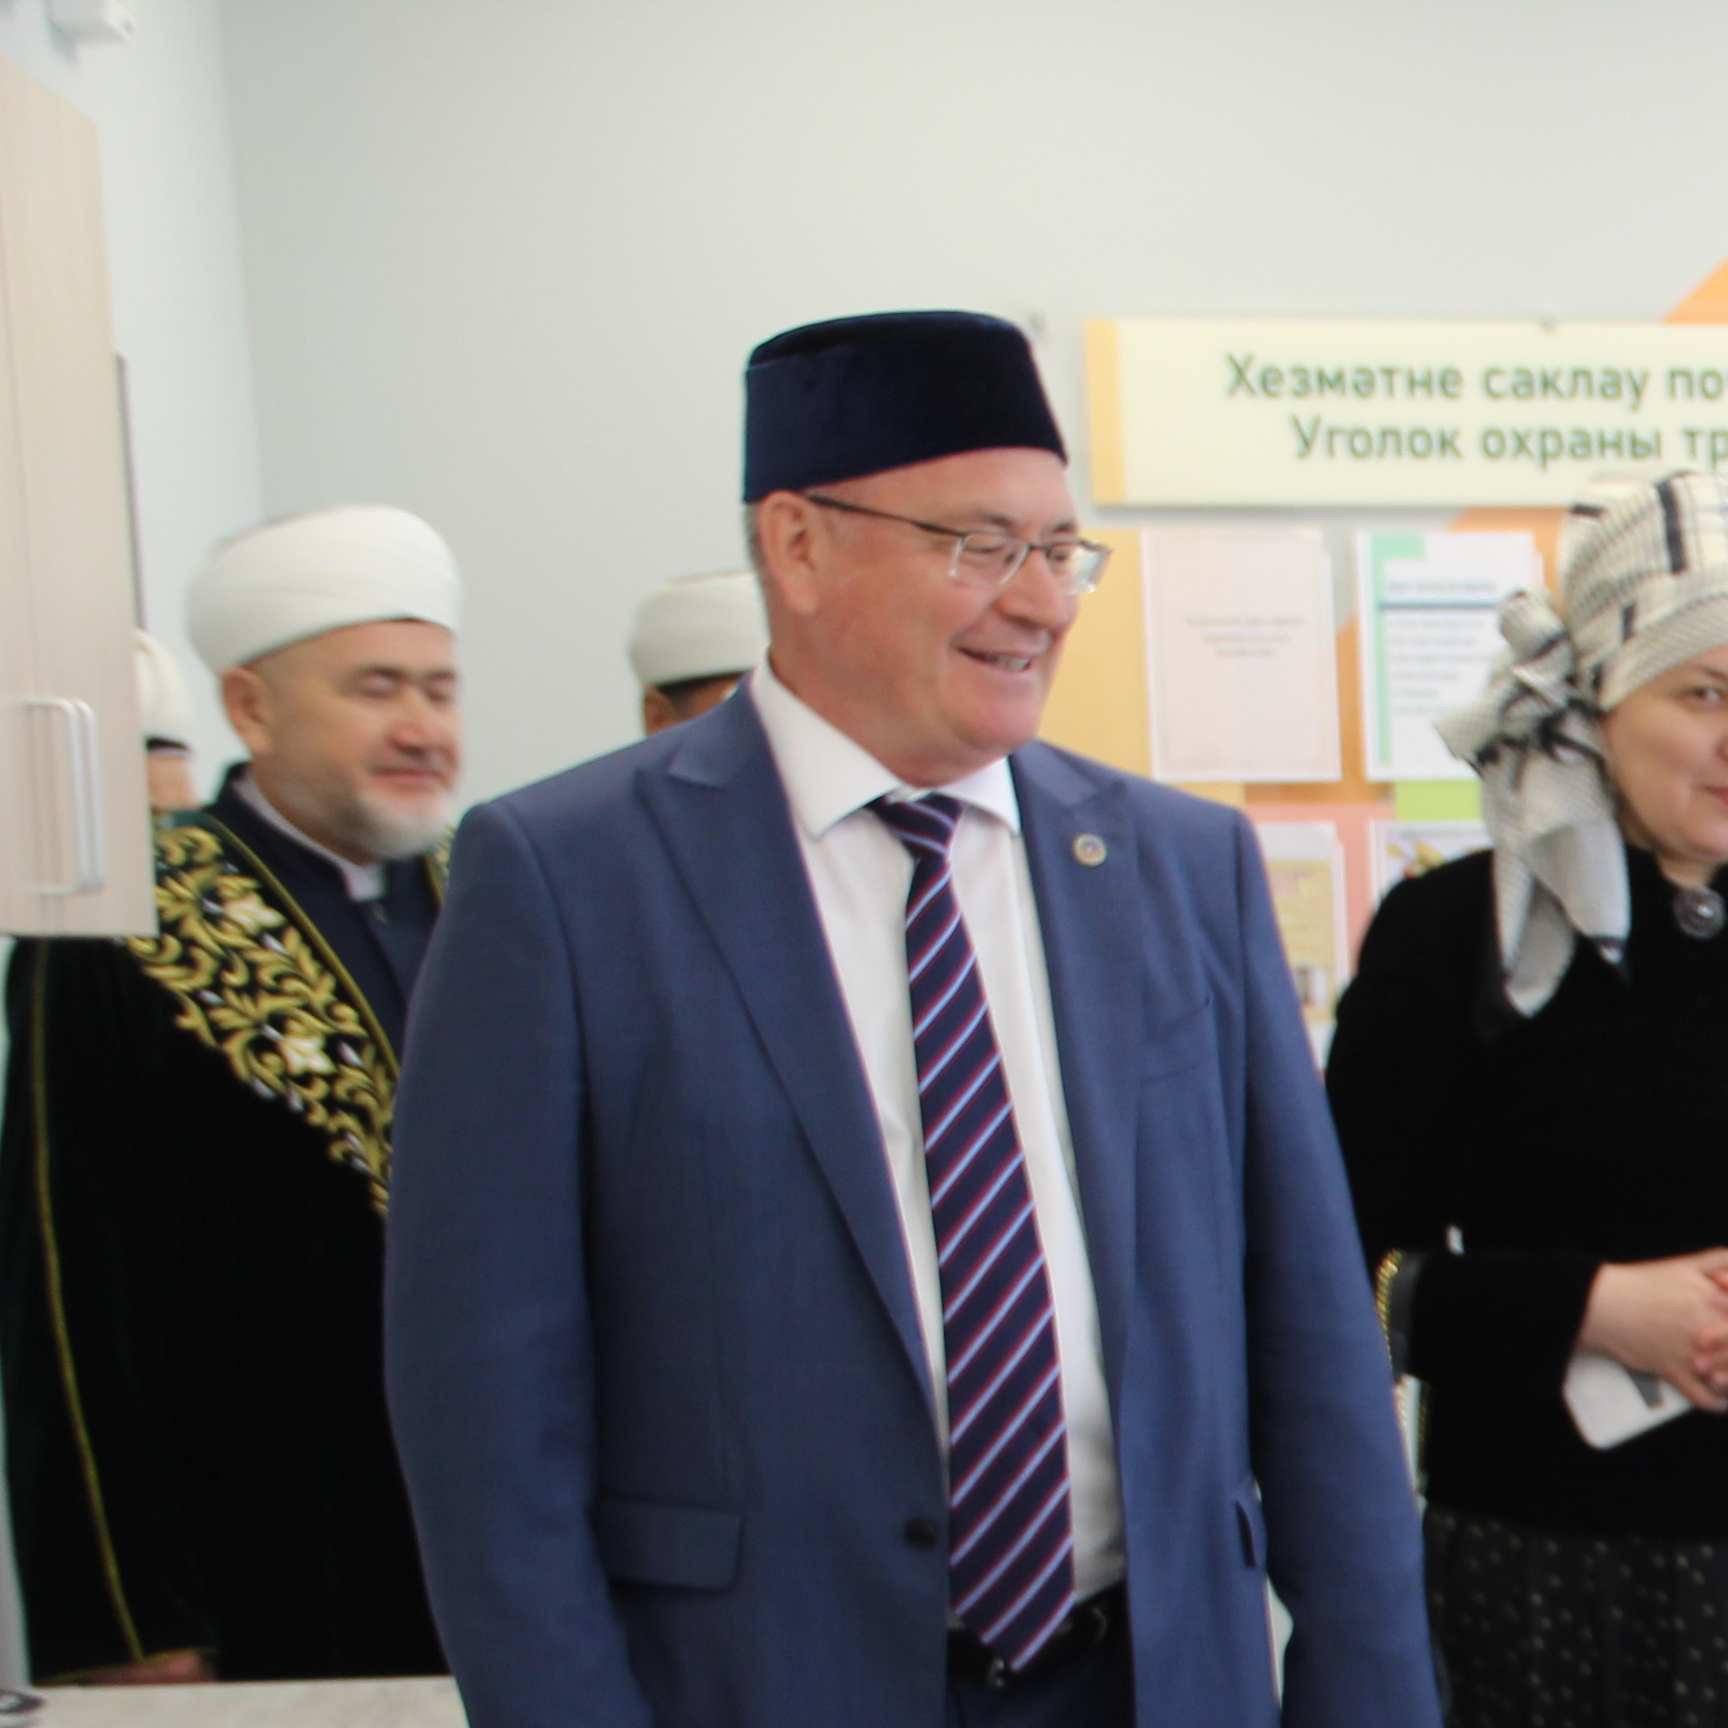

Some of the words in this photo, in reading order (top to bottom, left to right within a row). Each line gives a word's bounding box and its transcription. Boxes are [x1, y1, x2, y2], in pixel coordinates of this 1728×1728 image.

[1225, 353, 1463, 399] Хезмәтне
[1483, 367, 1648, 412] саклау
[1290, 415, 1464, 460] Уголок
[1481, 428, 1662, 471] охраны
